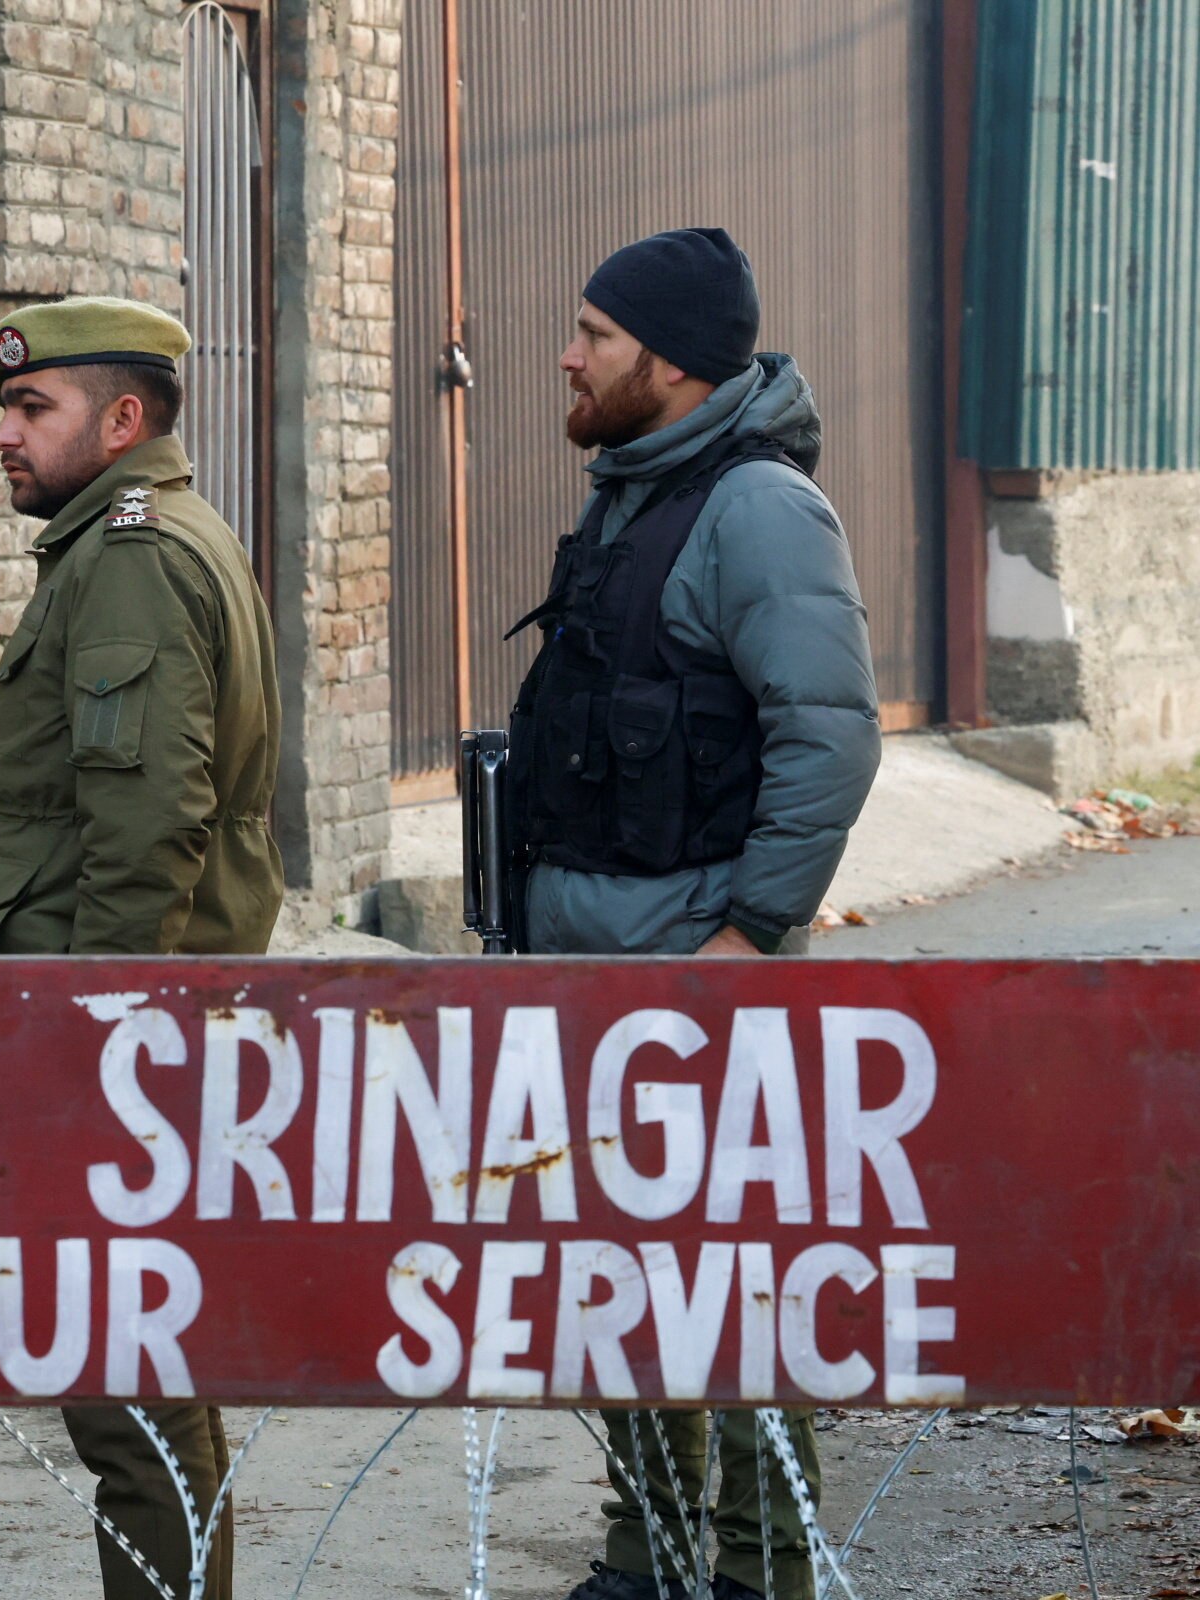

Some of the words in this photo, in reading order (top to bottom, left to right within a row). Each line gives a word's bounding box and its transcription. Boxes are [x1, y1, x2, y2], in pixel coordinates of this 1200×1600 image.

[112, 514, 147, 527] JKP
[86, 1005, 938, 1230] SRINAGAR
[375, 1239, 966, 1405] SERVICE
